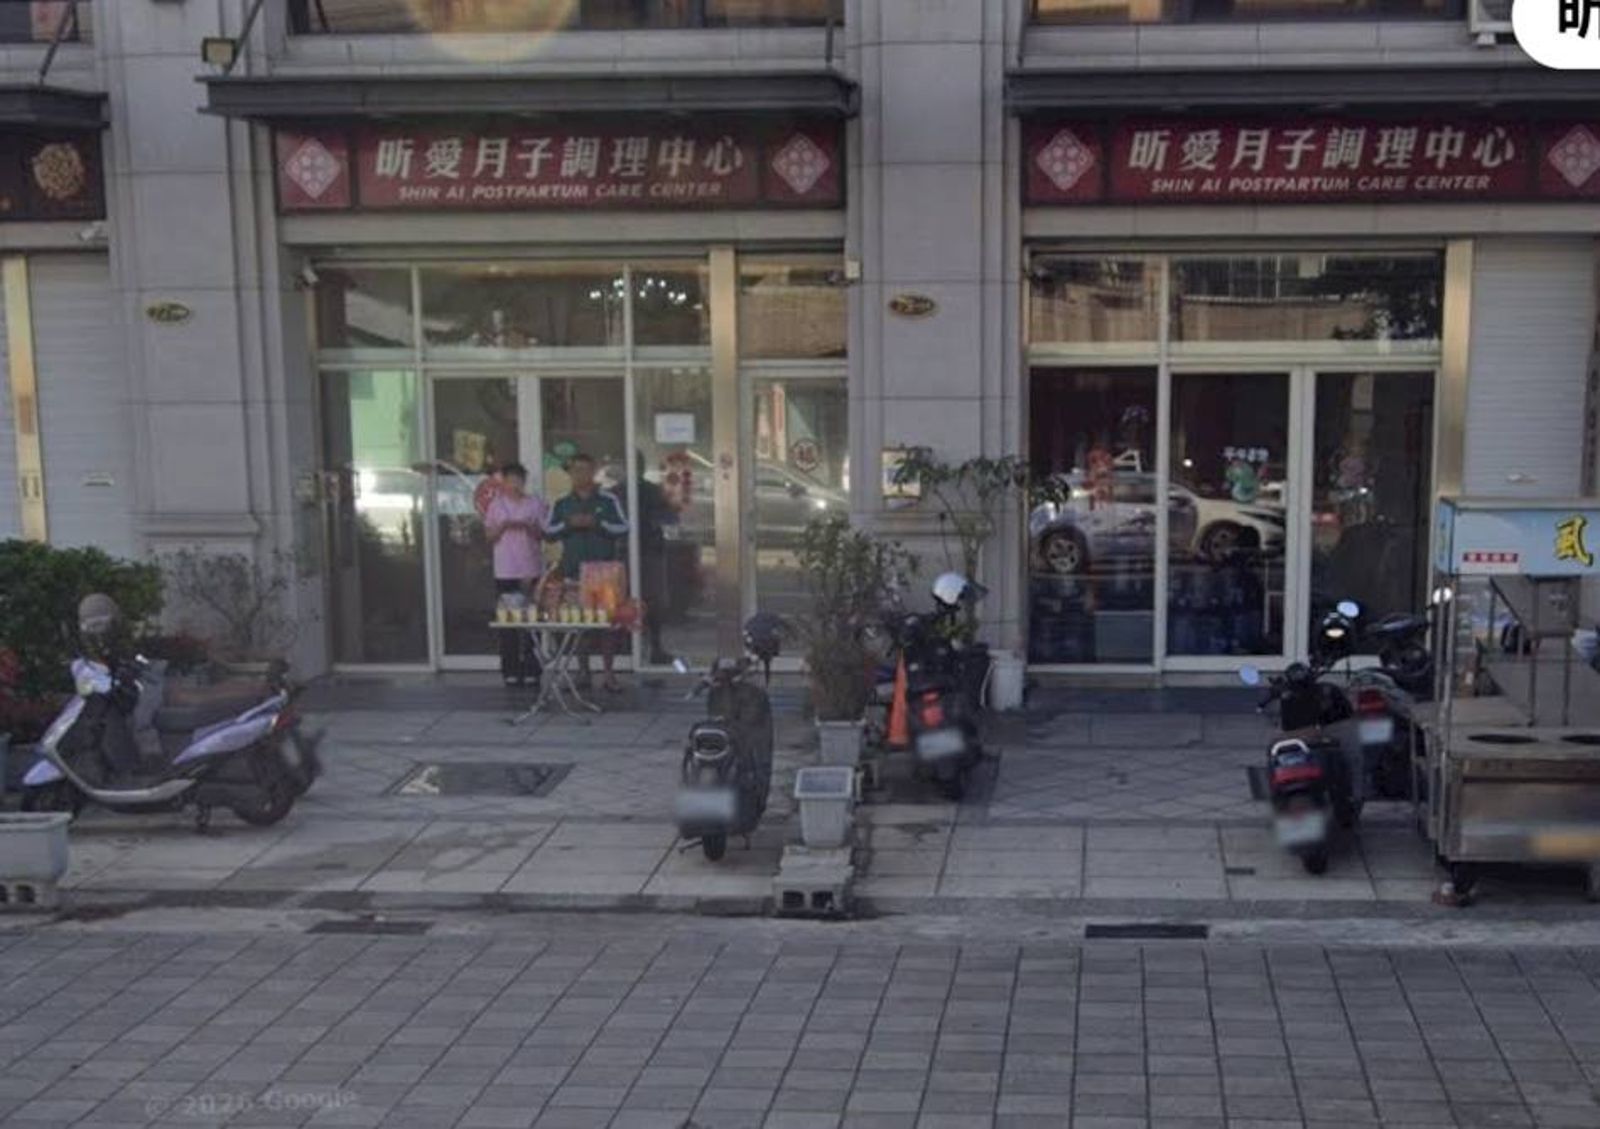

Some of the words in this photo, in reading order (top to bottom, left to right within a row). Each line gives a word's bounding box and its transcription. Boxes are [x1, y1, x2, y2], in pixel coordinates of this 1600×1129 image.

[376, 137, 743, 178] 昕愛月子調理中心
[1130, 127, 1514, 172] 昕愛月子調理中心
[400, 184, 439, 200] SHIN
[446, 185, 466, 200] AI
[472, 183, 588, 200] POSTPARTUM
[594, 182, 643, 199] CARE
[649, 181, 722, 198] CENTER
[1151, 178, 1193, 193] SHIN
[1200, 178, 1222, 192] AI
[1228, 177, 1350, 192] POSTPARTUM
[1357, 176, 1407, 191] CARE
[1413, 175, 1492, 190] CENTER
